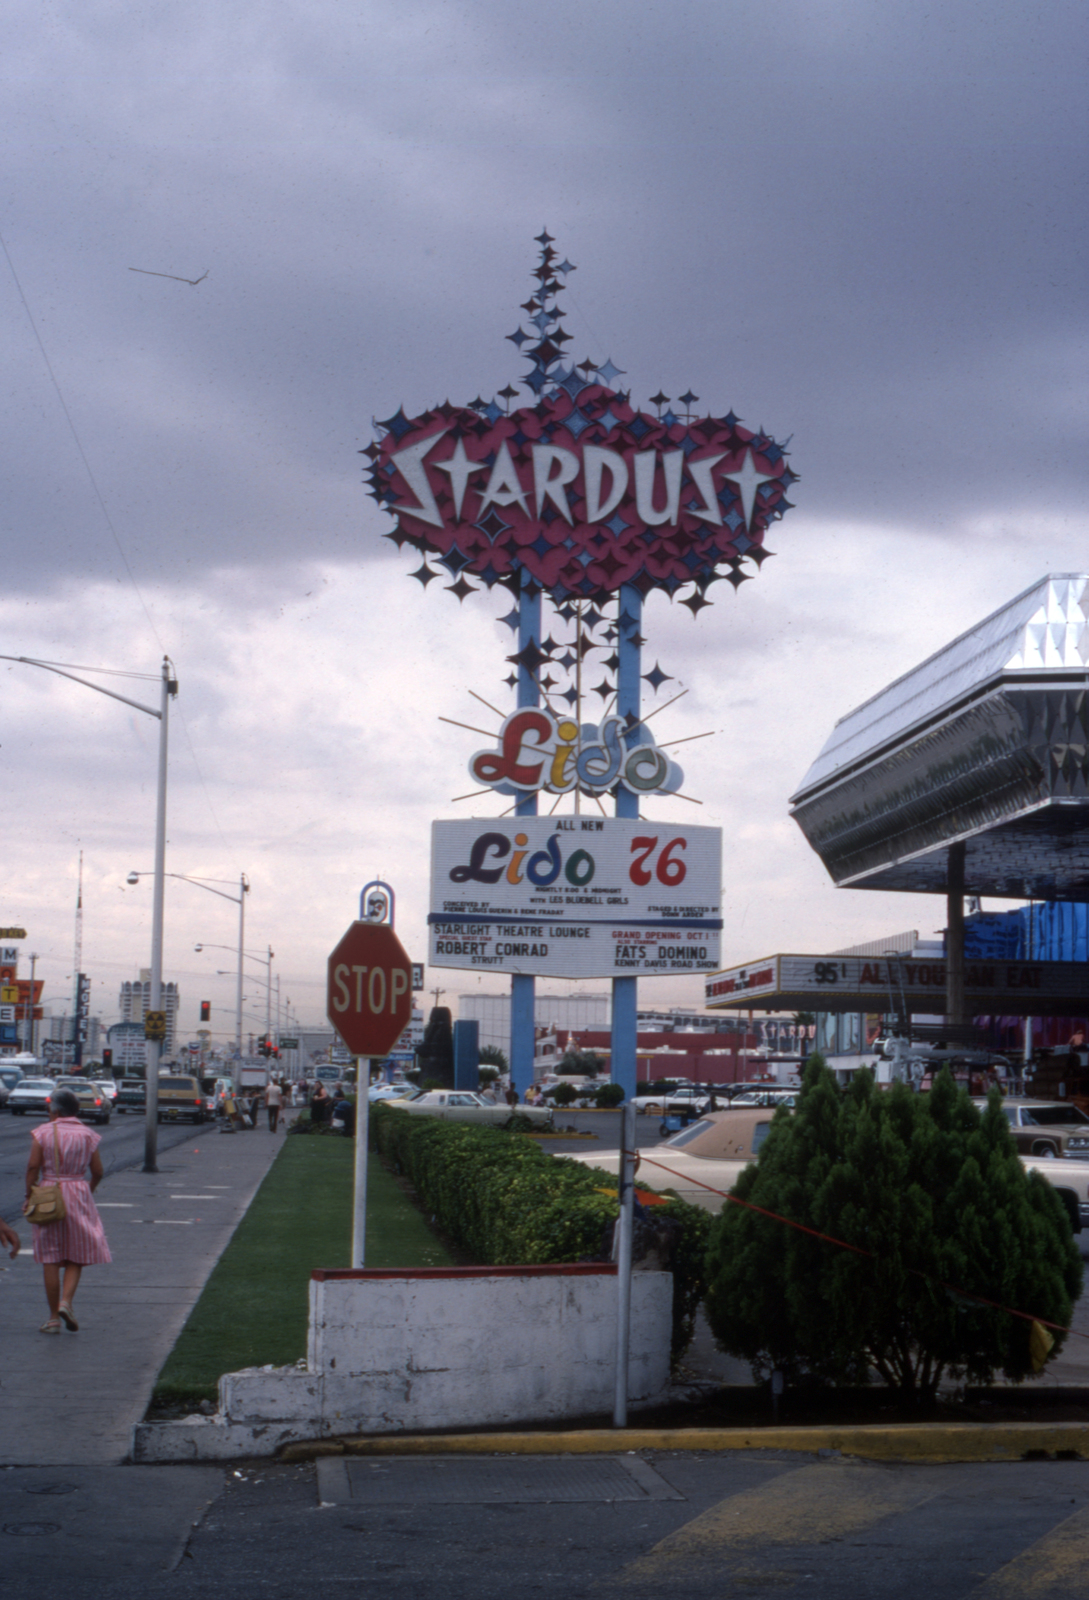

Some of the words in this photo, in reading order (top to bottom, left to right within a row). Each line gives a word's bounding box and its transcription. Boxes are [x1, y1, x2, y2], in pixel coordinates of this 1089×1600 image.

[388, 427, 778, 533] STARDUST
[472, 710, 668, 790] Lido
[556, 820, 576, 831] ALL
[581, 820, 604, 831] NEW
[449, 832, 595, 887] Lido
[629, 836, 687, 887] 76
[549, 896, 563, 904] LES
[566, 896, 604, 904] BLUEBELL
[606, 897, 629, 905] GIRLS
[434, 924, 491, 936] STARLIGHT
[496, 925, 543, 937] THEATRE
[550, 927, 590, 938] LOUNGE
[612, 931, 641, 939] GRAND
[645, 931, 681, 940] OPENING
[687, 932, 703, 940] OCT
[436, 941, 487, 955] ROBERT
[495, 943, 548, 957] CONRAD
[615, 945, 646, 958] FATS
[658, 946, 707, 959] DOMINO
[471, 956, 504, 964] STRUTT
[614, 959, 640, 967] KENNY
[671, 960, 693, 968] ROAD
[696, 960, 719, 968] SHOW
[859, 962, 898, 985] ALL
[904, 964, 947, 986] YOU
[964, 966, 995, 988] AN
[1006, 966, 1044, 988] EAT
[333, 964, 408, 1014] STOP
[80, 979, 91, 1042] MOTEL
